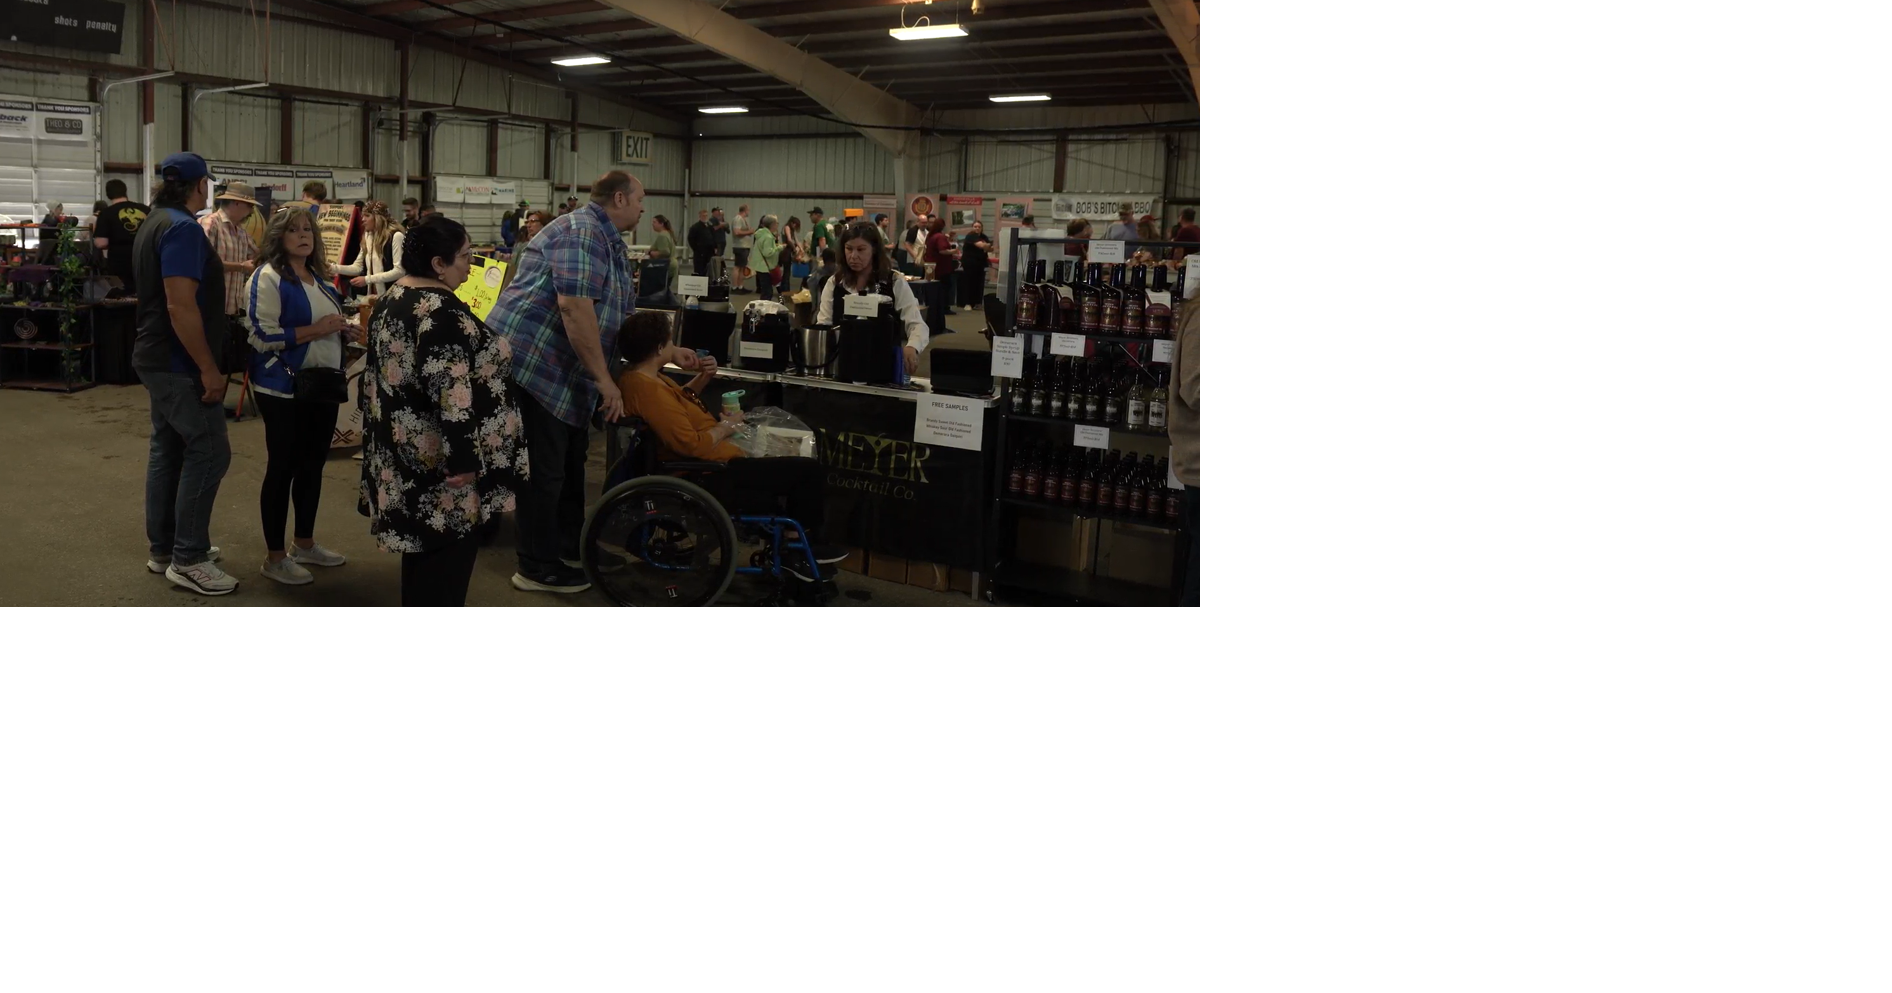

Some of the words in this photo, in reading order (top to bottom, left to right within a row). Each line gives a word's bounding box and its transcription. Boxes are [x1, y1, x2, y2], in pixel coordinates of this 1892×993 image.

[55, 15, 78, 28] shots
[86, 20, 117, 33] penalty
[626, 135, 650, 159] EXIT
[1076, 202, 1099, 214] BOB'S
[819, 427, 931, 484] MEYER
[826, 472, 890, 496] Cocktail
[893, 485, 917, 501] Co.
